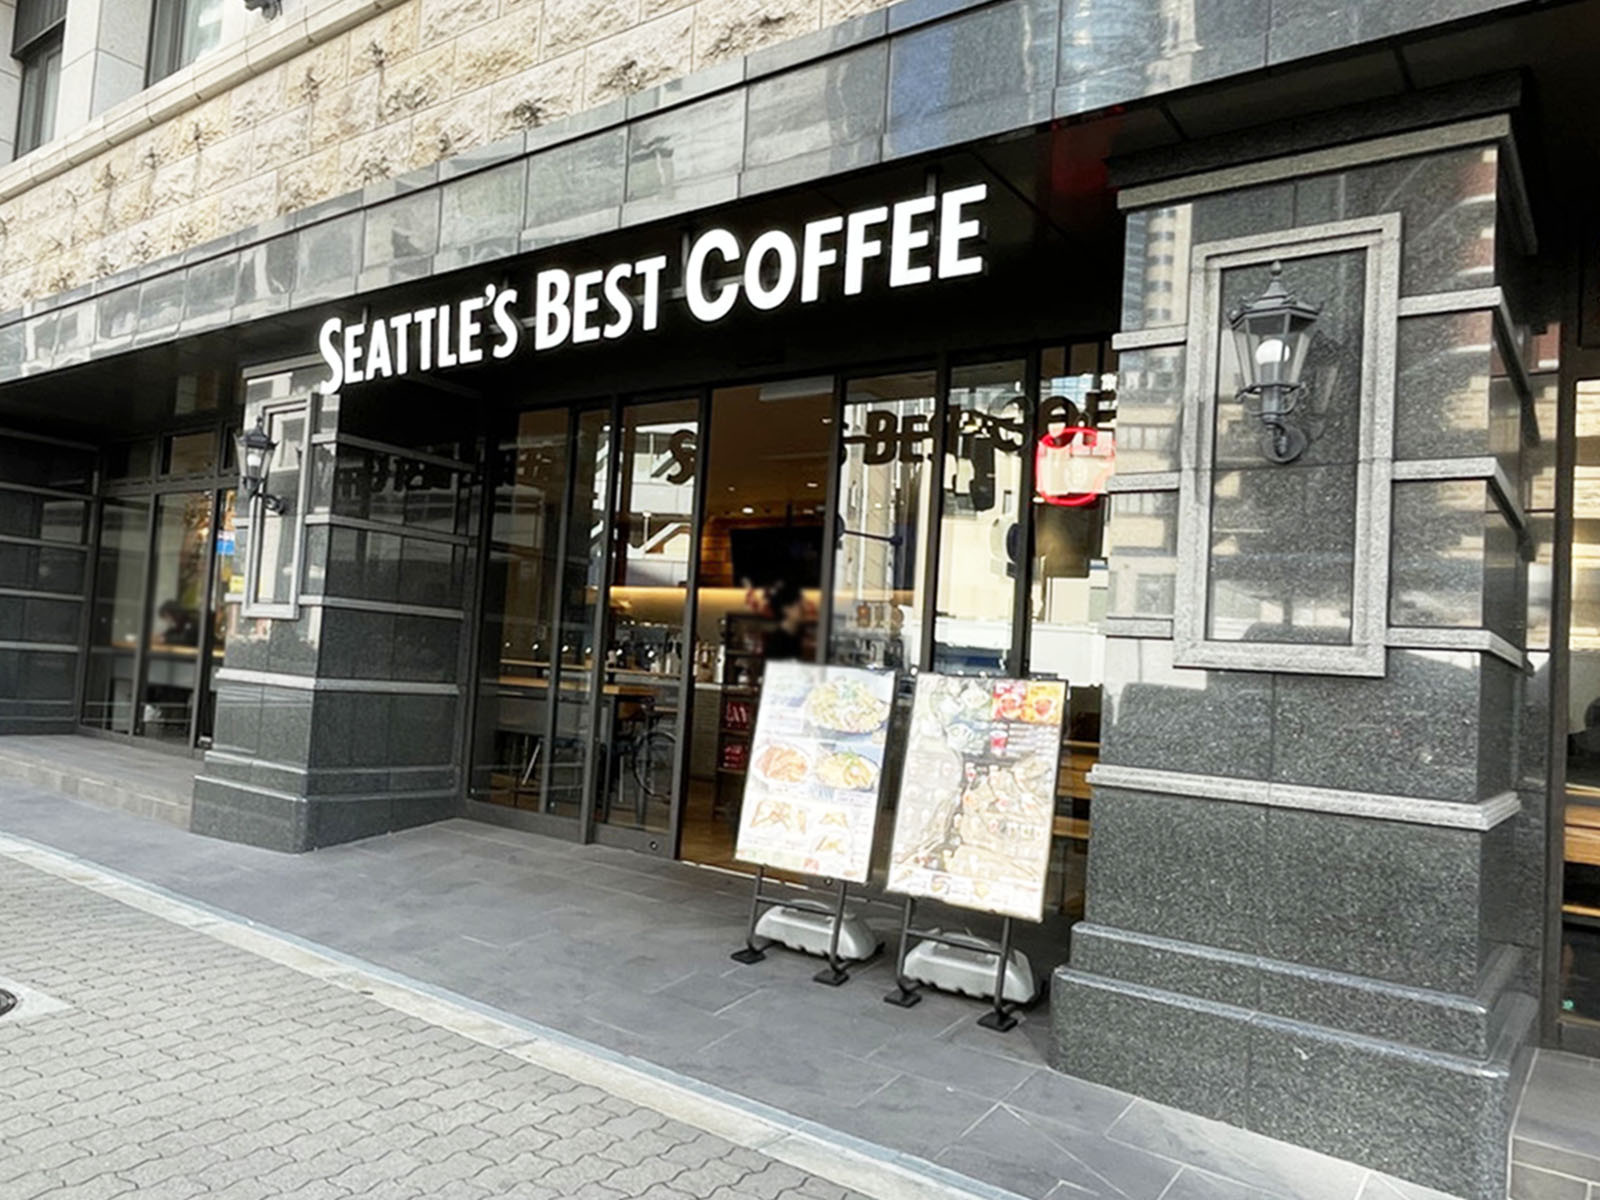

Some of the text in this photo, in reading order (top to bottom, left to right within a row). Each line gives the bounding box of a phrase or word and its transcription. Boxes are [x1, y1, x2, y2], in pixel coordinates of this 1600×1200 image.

[318, 183, 989, 395] SEATTLE'S BEST COFFEE
